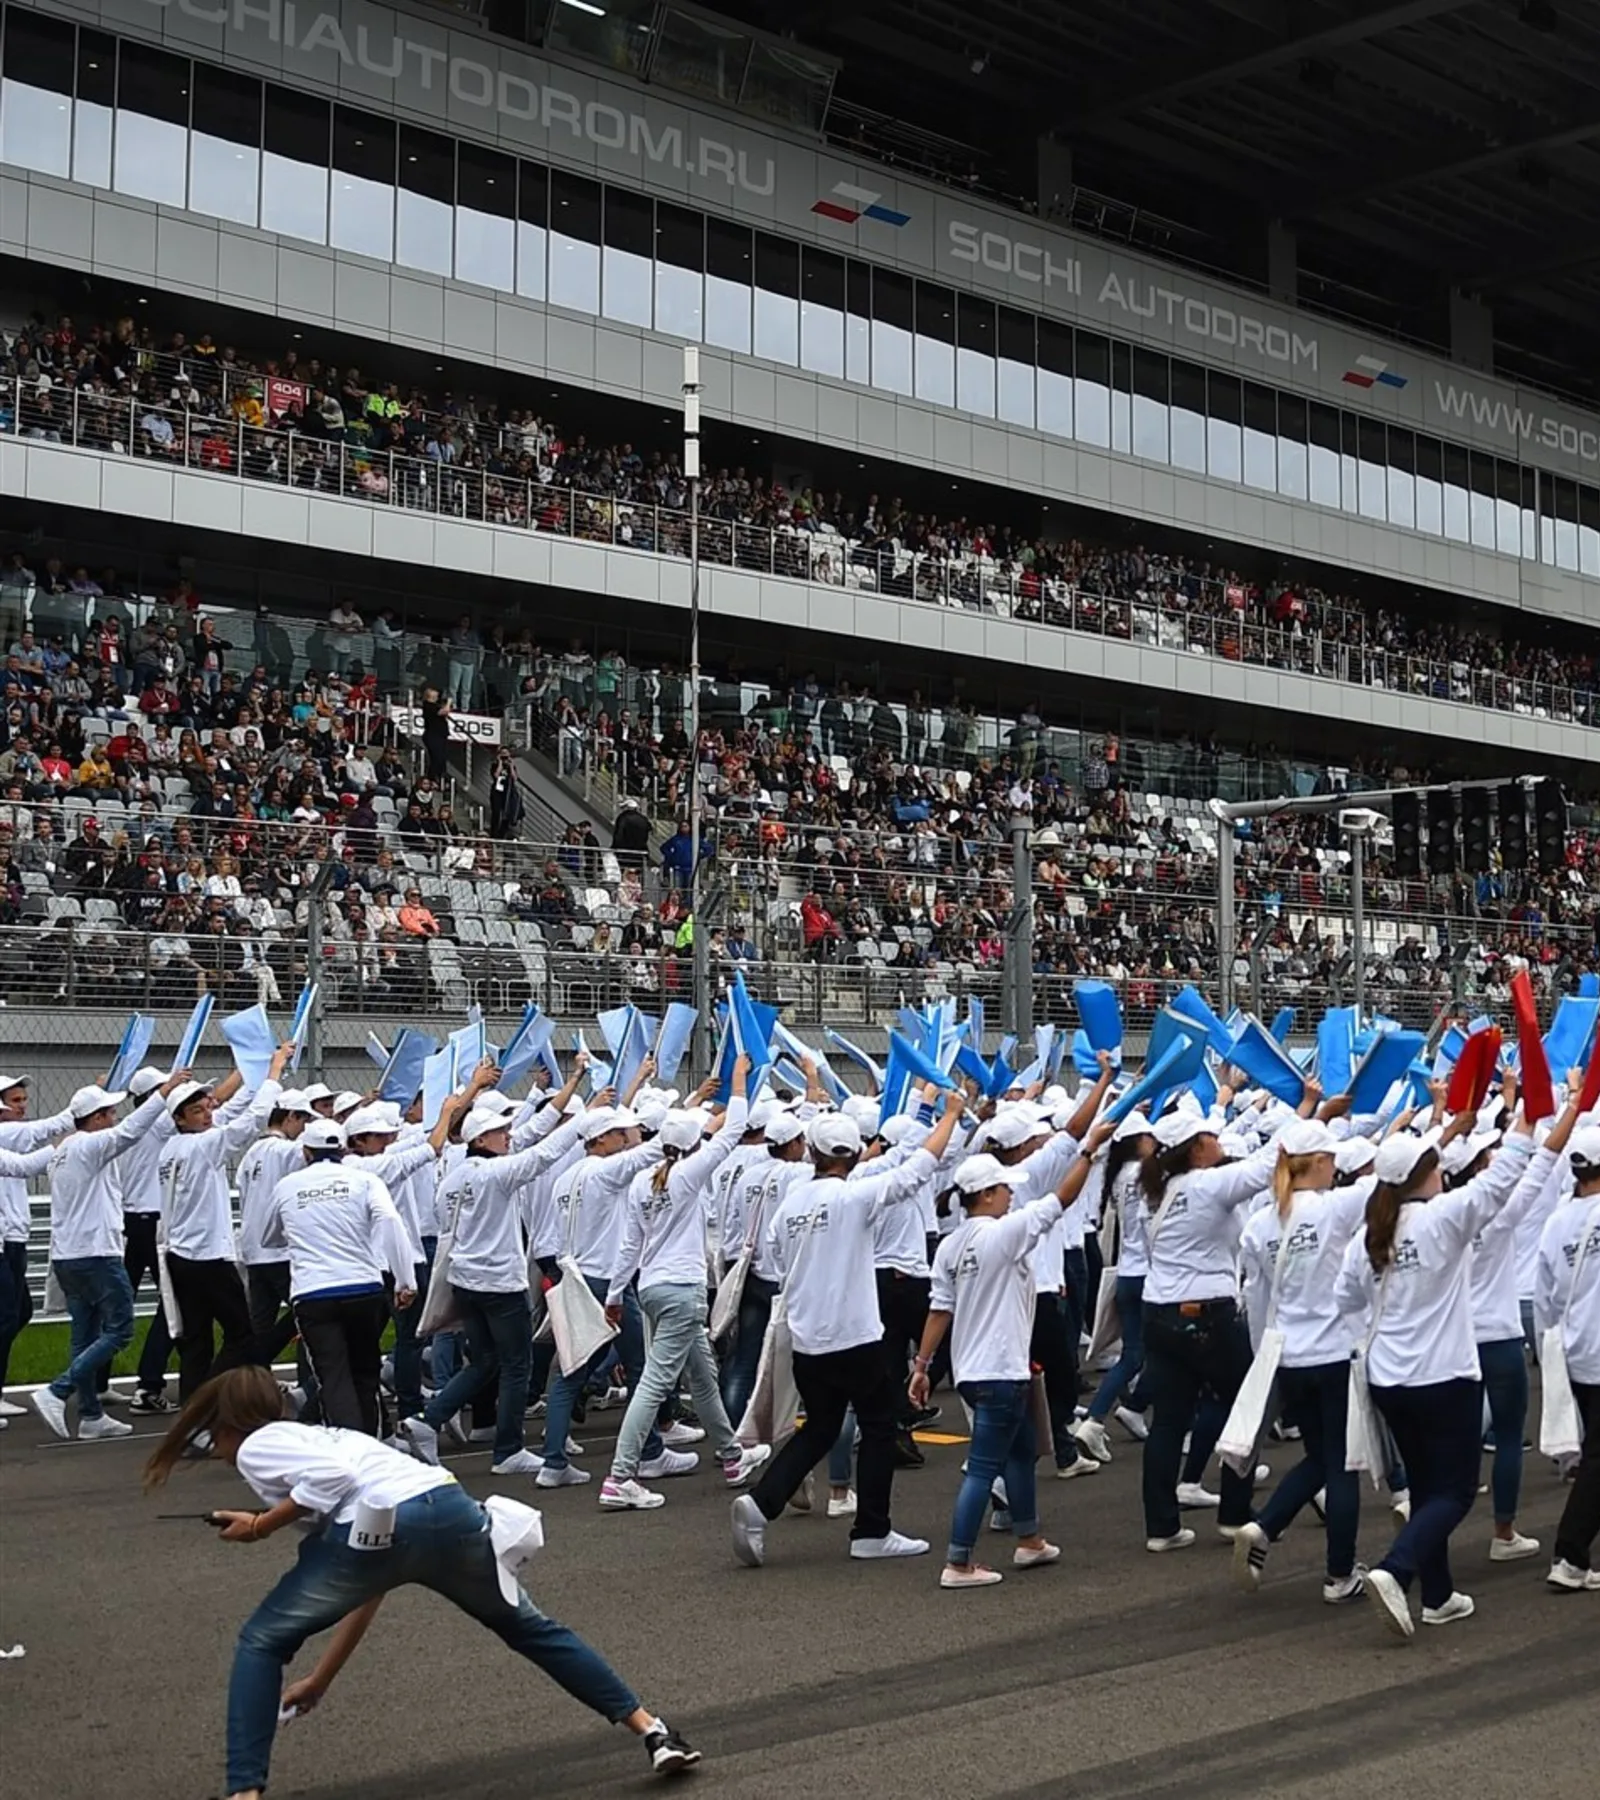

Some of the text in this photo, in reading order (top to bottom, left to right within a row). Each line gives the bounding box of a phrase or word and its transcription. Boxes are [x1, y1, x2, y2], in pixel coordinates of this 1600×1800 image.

[145, 0, 775, 196] HIAUTODROM.RU
[949, 220, 1318, 372] SOCHI AUTODROM
[272, 382, 302, 397] 404
[297, 1187, 350, 1200] SOCHI
[1267, 1232, 1318, 1251] SCHI
